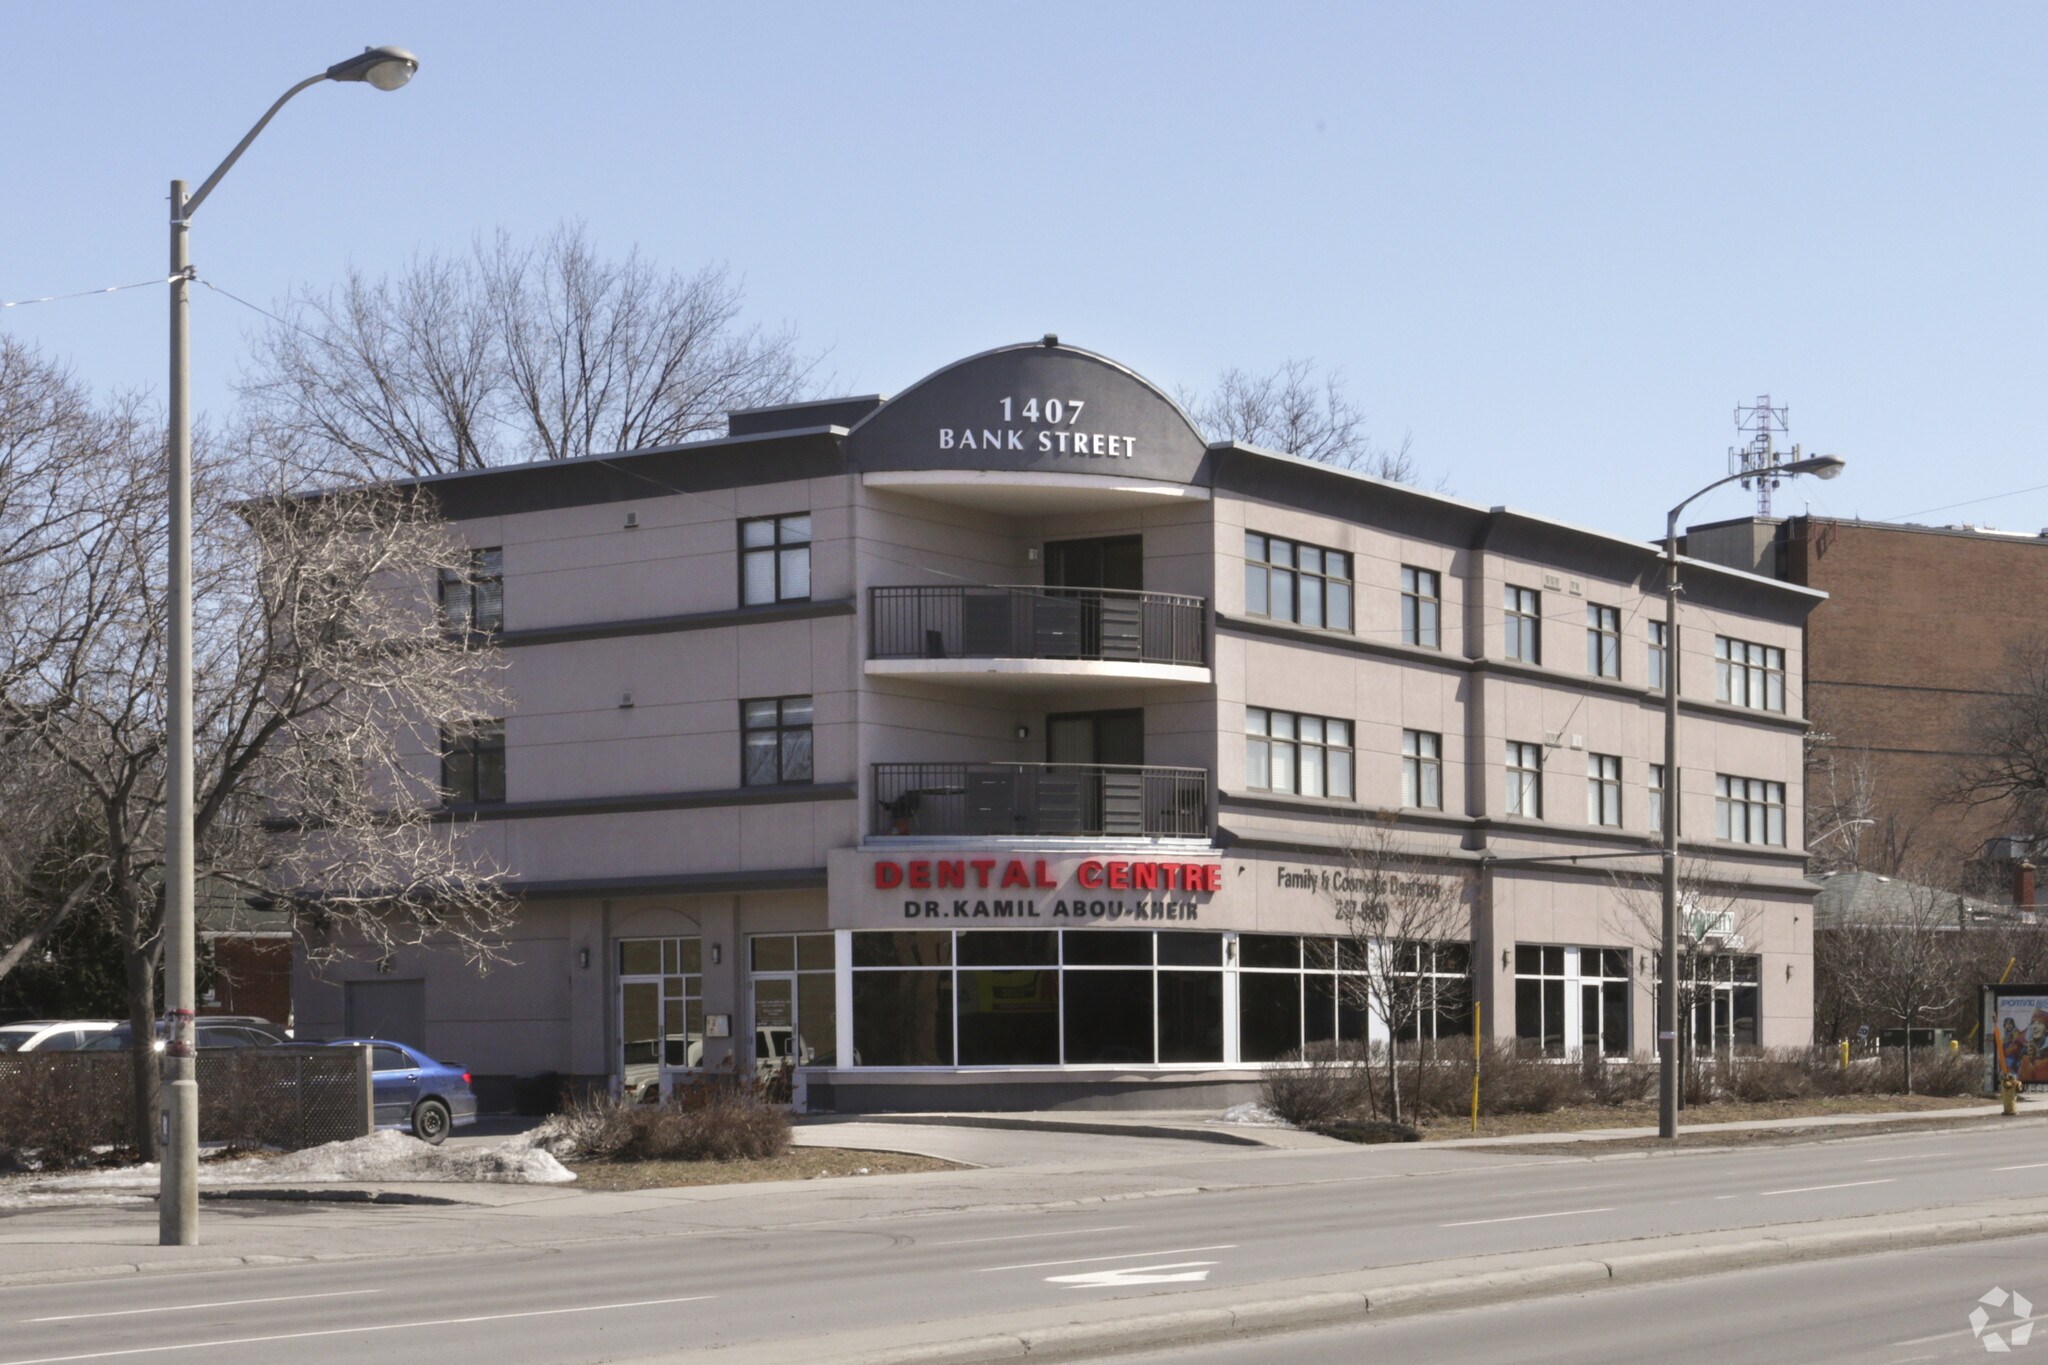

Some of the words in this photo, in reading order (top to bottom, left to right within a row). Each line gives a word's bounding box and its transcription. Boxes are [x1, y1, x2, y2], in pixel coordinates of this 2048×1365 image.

[1000, 396, 1085, 425] 1407
[939, 428, 1024, 450] BANK
[1038, 431, 1137, 458] STREET
[875, 860, 1057, 889] DENTAL
[1078, 860, 1222, 892] CENTRE
[1277, 866, 1318, 895] Family
[1053, 900, 1198, 921] ABOU-KHEIR
